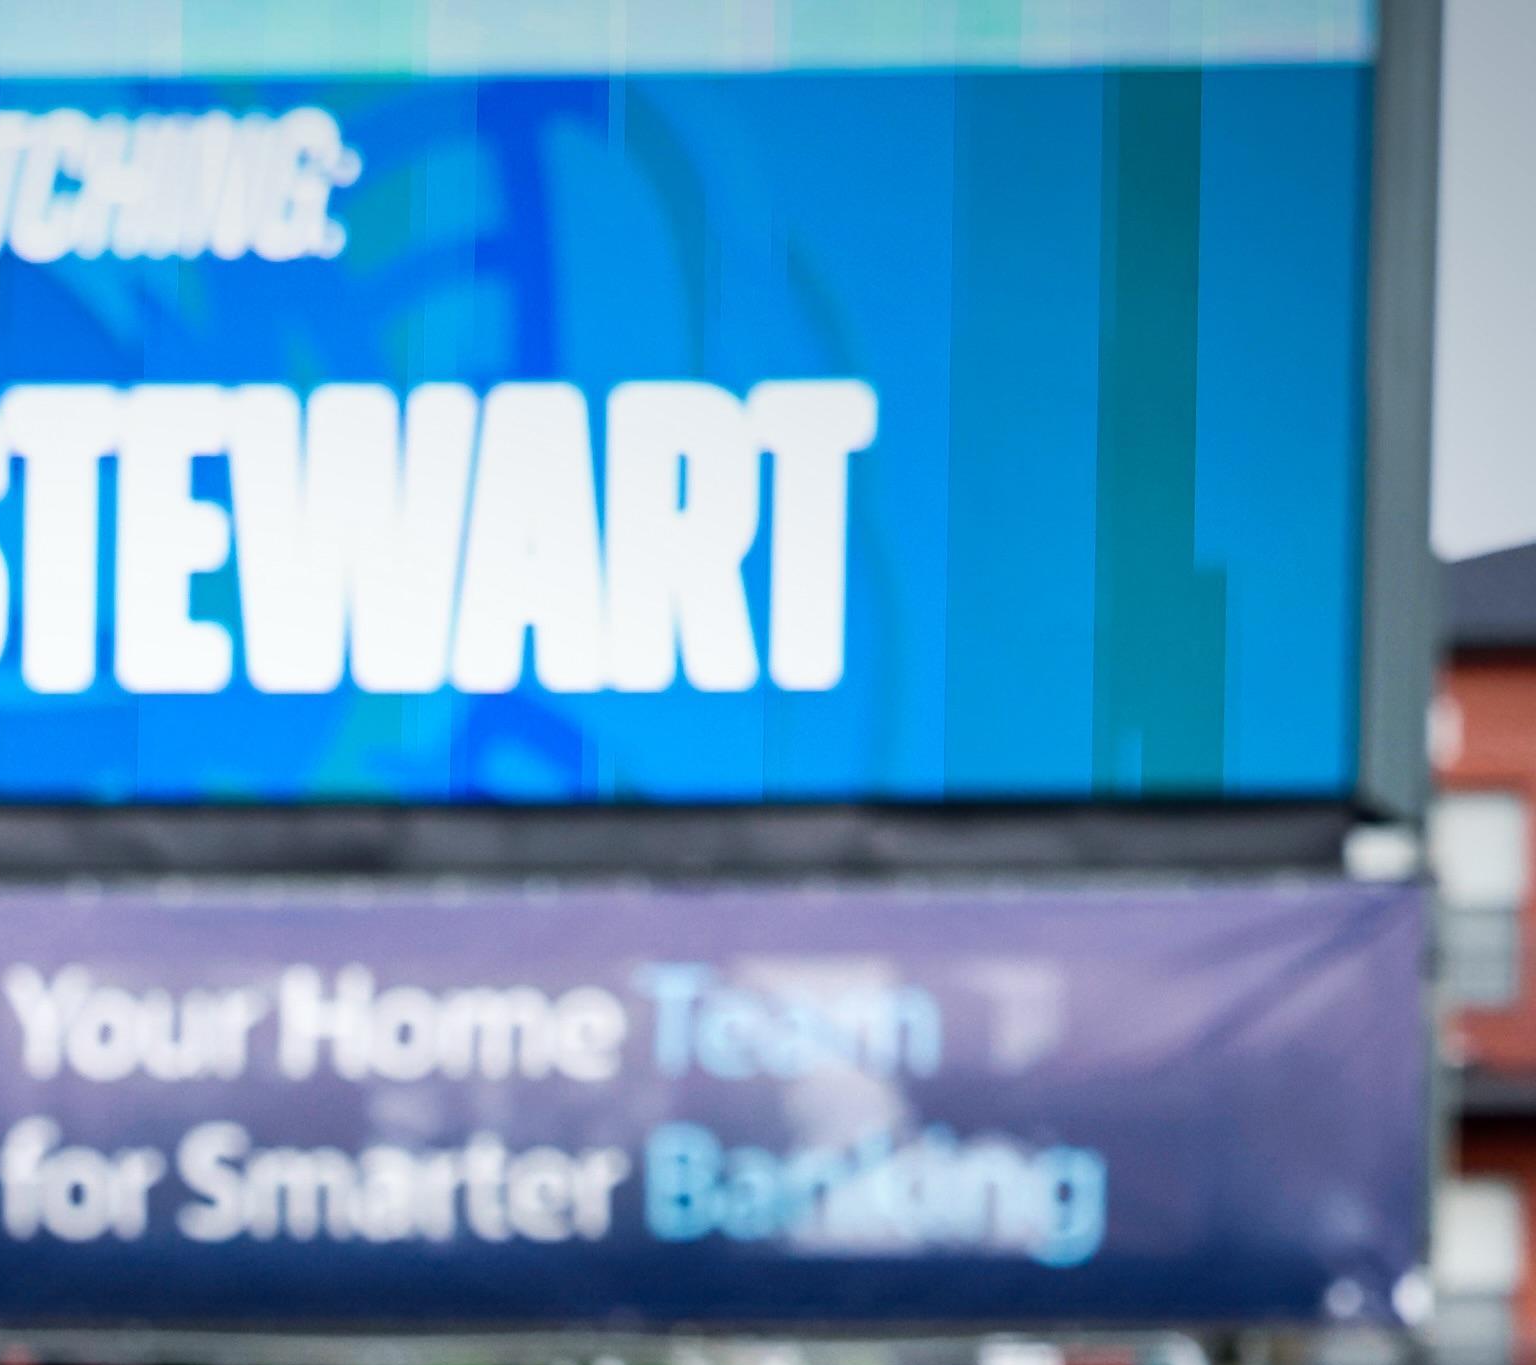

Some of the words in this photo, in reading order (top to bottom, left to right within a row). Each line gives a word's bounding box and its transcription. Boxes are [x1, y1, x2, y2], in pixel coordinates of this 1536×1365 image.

[3, 962, 269, 1082] Your
[276, 962, 628, 1082] Home
[634, 962, 944, 1080] Team
[174, 1120, 632, 1242] Smarter
[644, 1118, 1109, 1268] Banking
